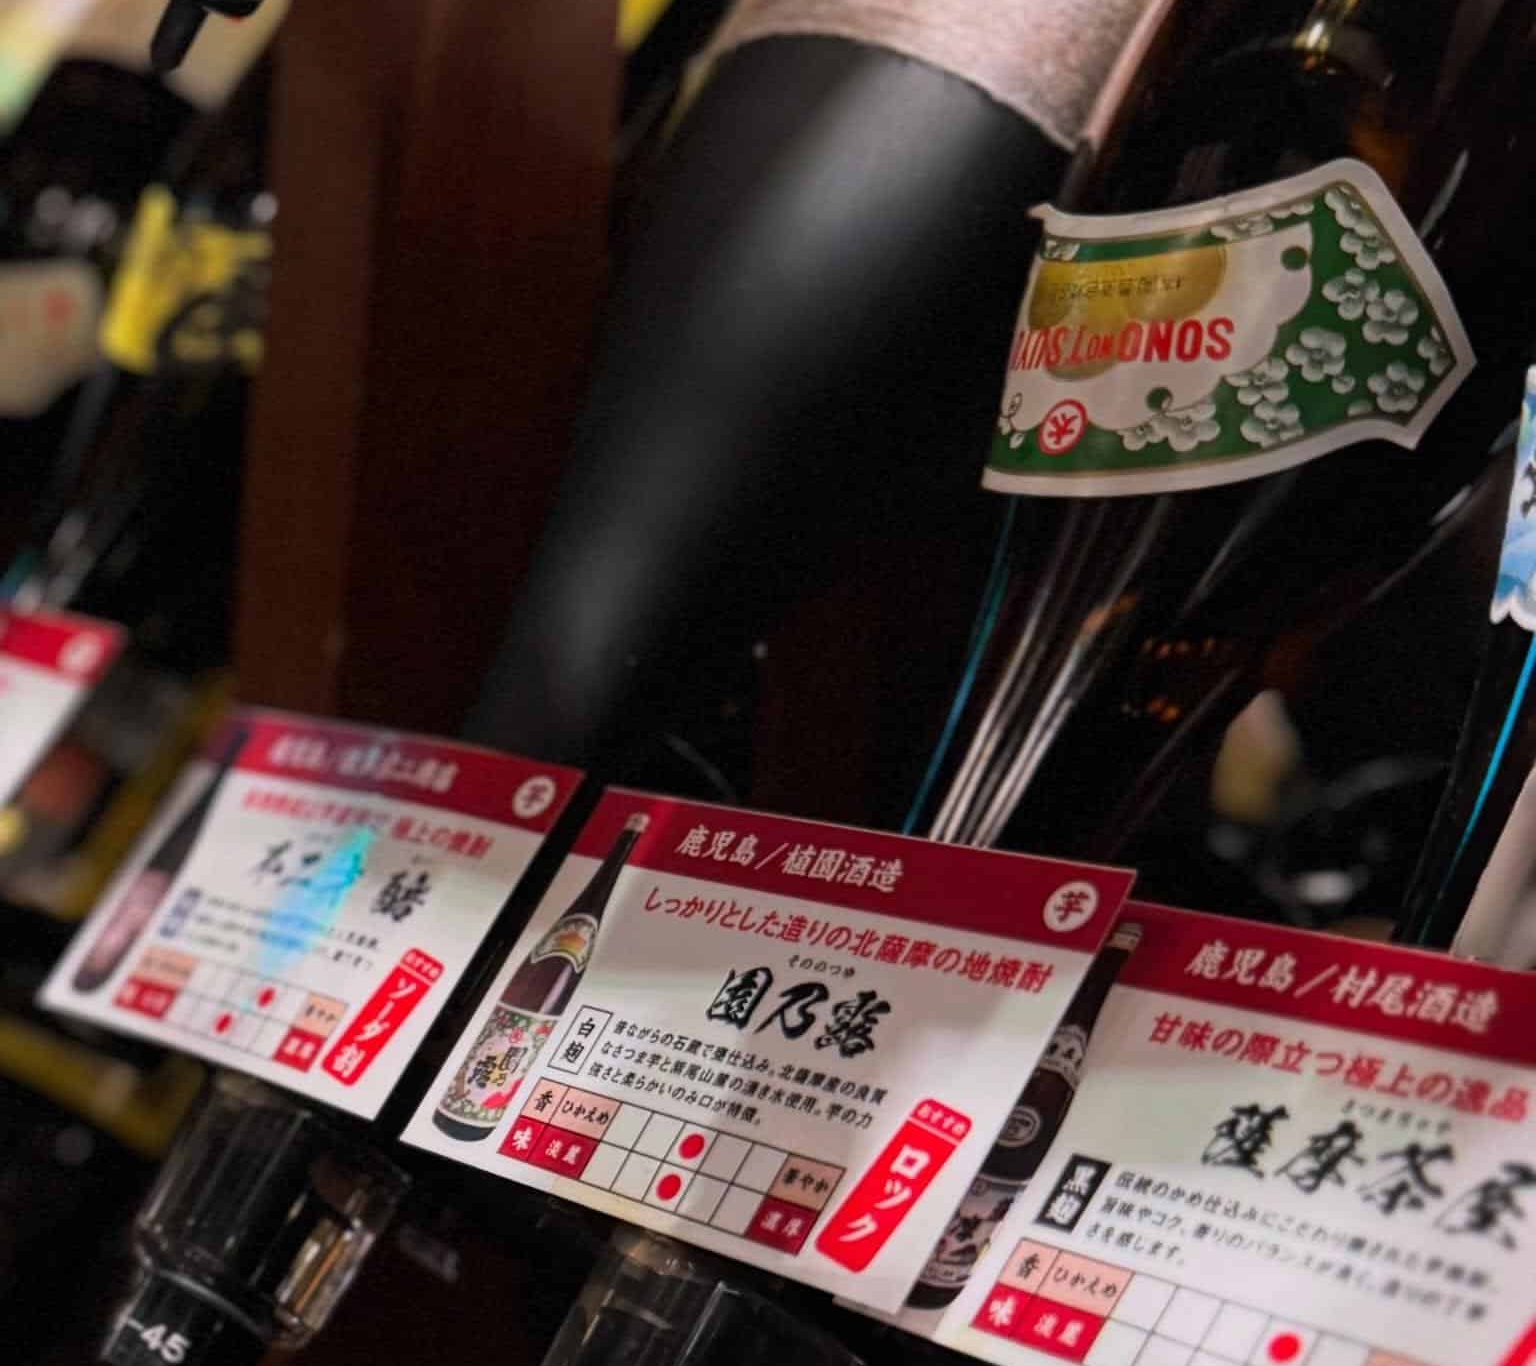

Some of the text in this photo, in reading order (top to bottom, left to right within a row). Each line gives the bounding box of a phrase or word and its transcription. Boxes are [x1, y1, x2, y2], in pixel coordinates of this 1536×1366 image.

[677, 825, 905, 893] 鹿児島／植園酒造
[1052, 891, 1091, 923] 芋
[644, 885, 1056, 995] しっかりとした造りの北薩摩の地焼酎
[705, 966, 893, 1059] 園乃露
[1184, 939, 1500, 1034] 鹿児島／村尾酒造
[332, 977, 417, 1078] ソーダ割
[563, 1017, 596, 1064] 白麹
[1148, 1011, 1530, 1123] 甘味の際立つ極上の逸品
[534, 1090, 554, 1113] 香
[562, 1100, 610, 1125] ひかえめ
[917, 1103, 967, 1134] おすすめ
[512, 1126, 533, 1151] 味
[838, 1143, 932, 1244] ロック
[1016, 1251, 1041, 1280] 香
[1053, 1266, 1118, 1299] ひかえめ
[988, 1297, 1017, 1328] 味
